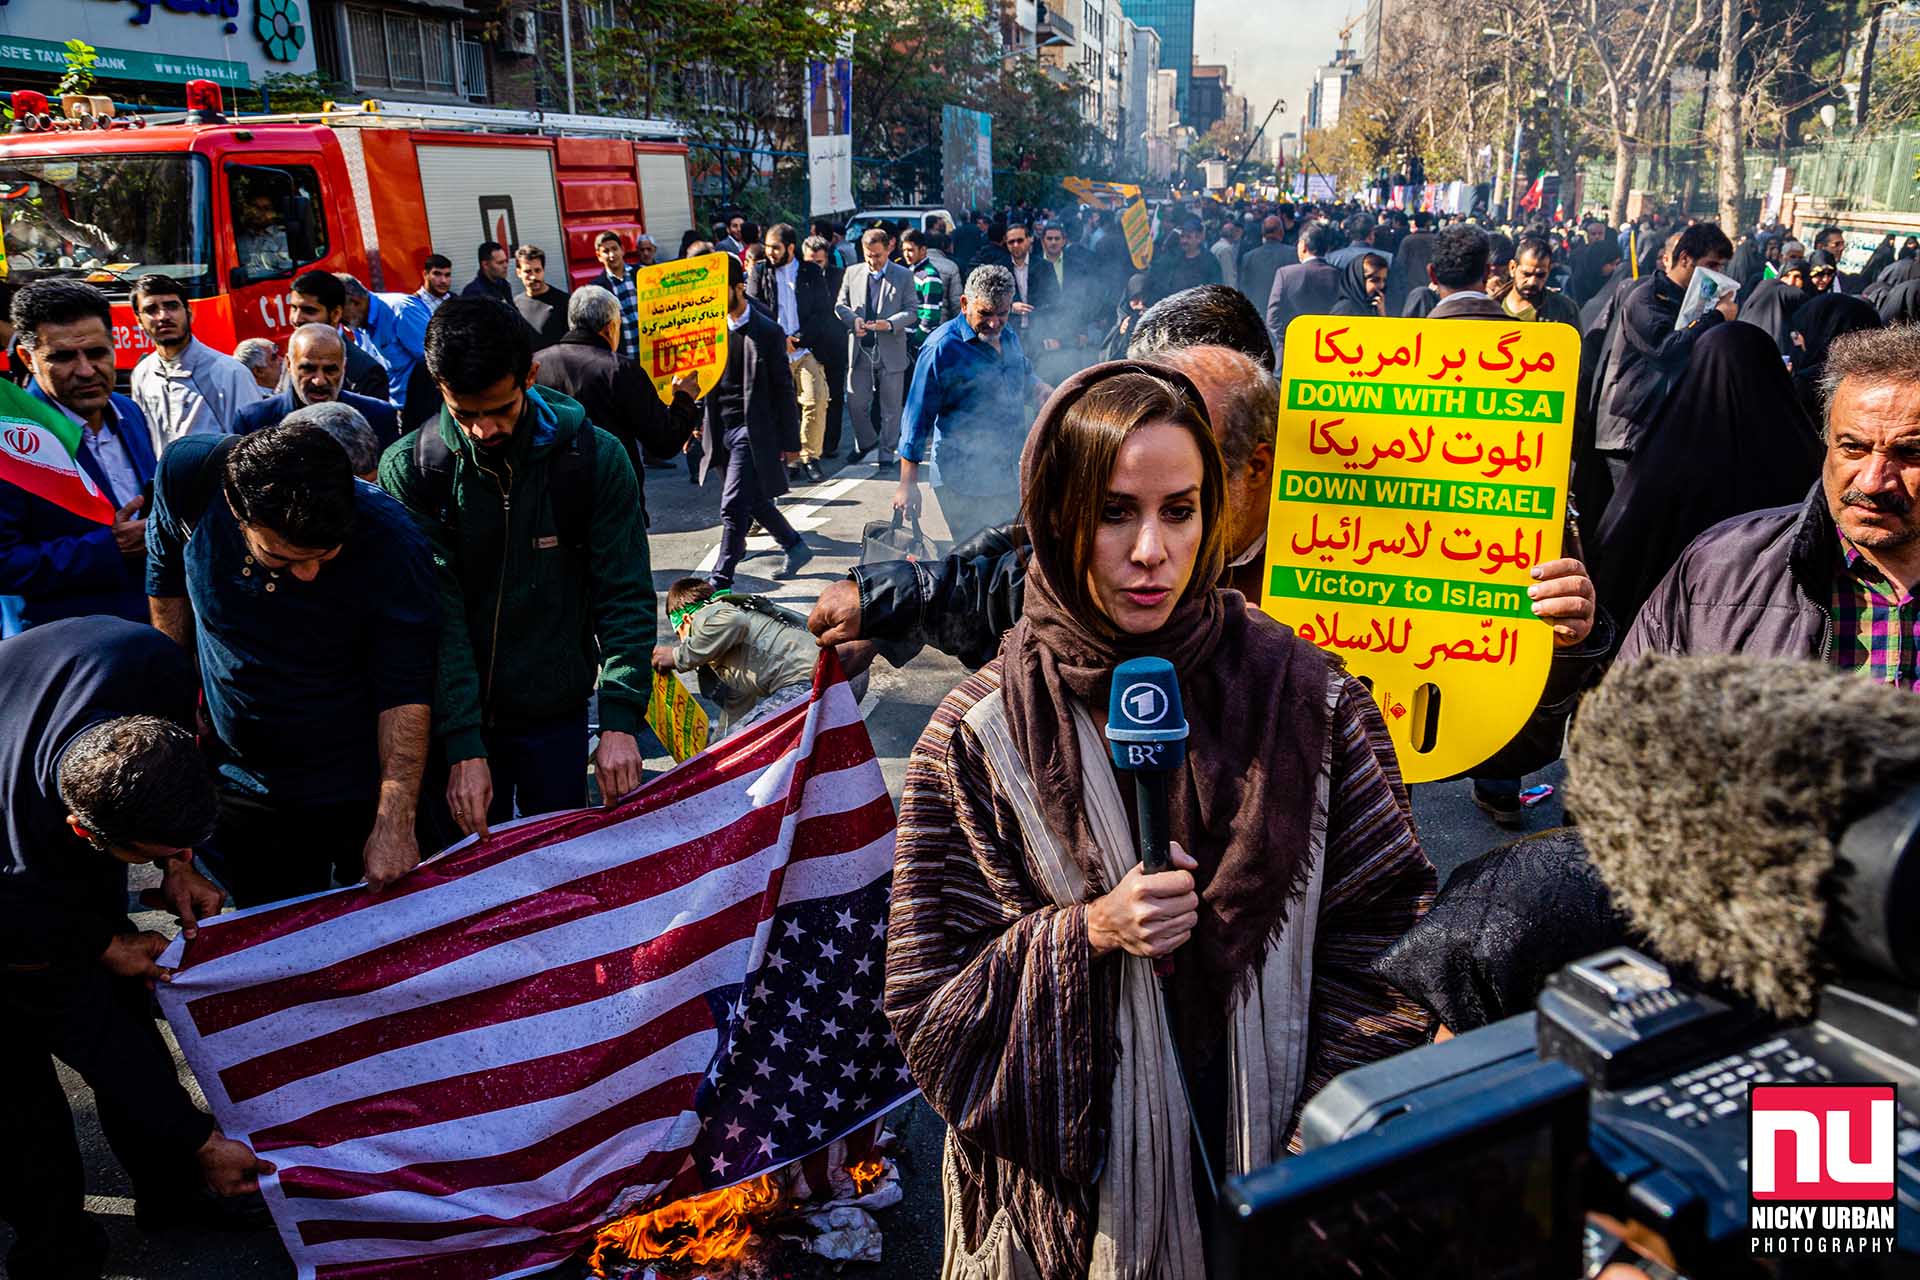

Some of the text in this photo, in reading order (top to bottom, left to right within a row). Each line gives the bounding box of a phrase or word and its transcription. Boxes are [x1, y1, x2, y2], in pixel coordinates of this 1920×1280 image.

[154, 62, 238, 81] www.ttbank.ir
[659, 341, 711, 373] USA
[1314, 327, 1554, 384] مرگ بر امریکا
[1297, 383, 1553, 418] DOWN WITH U.S.A
[1442, 431, 1544, 478] الموت
[1285, 474, 1547, 514] DOWN WITH ISRAEL
[1441, 528, 1543, 575] الموت
[1295, 569, 1520, 611] Victory to Islam
[1128, 744, 1159, 766] BR
